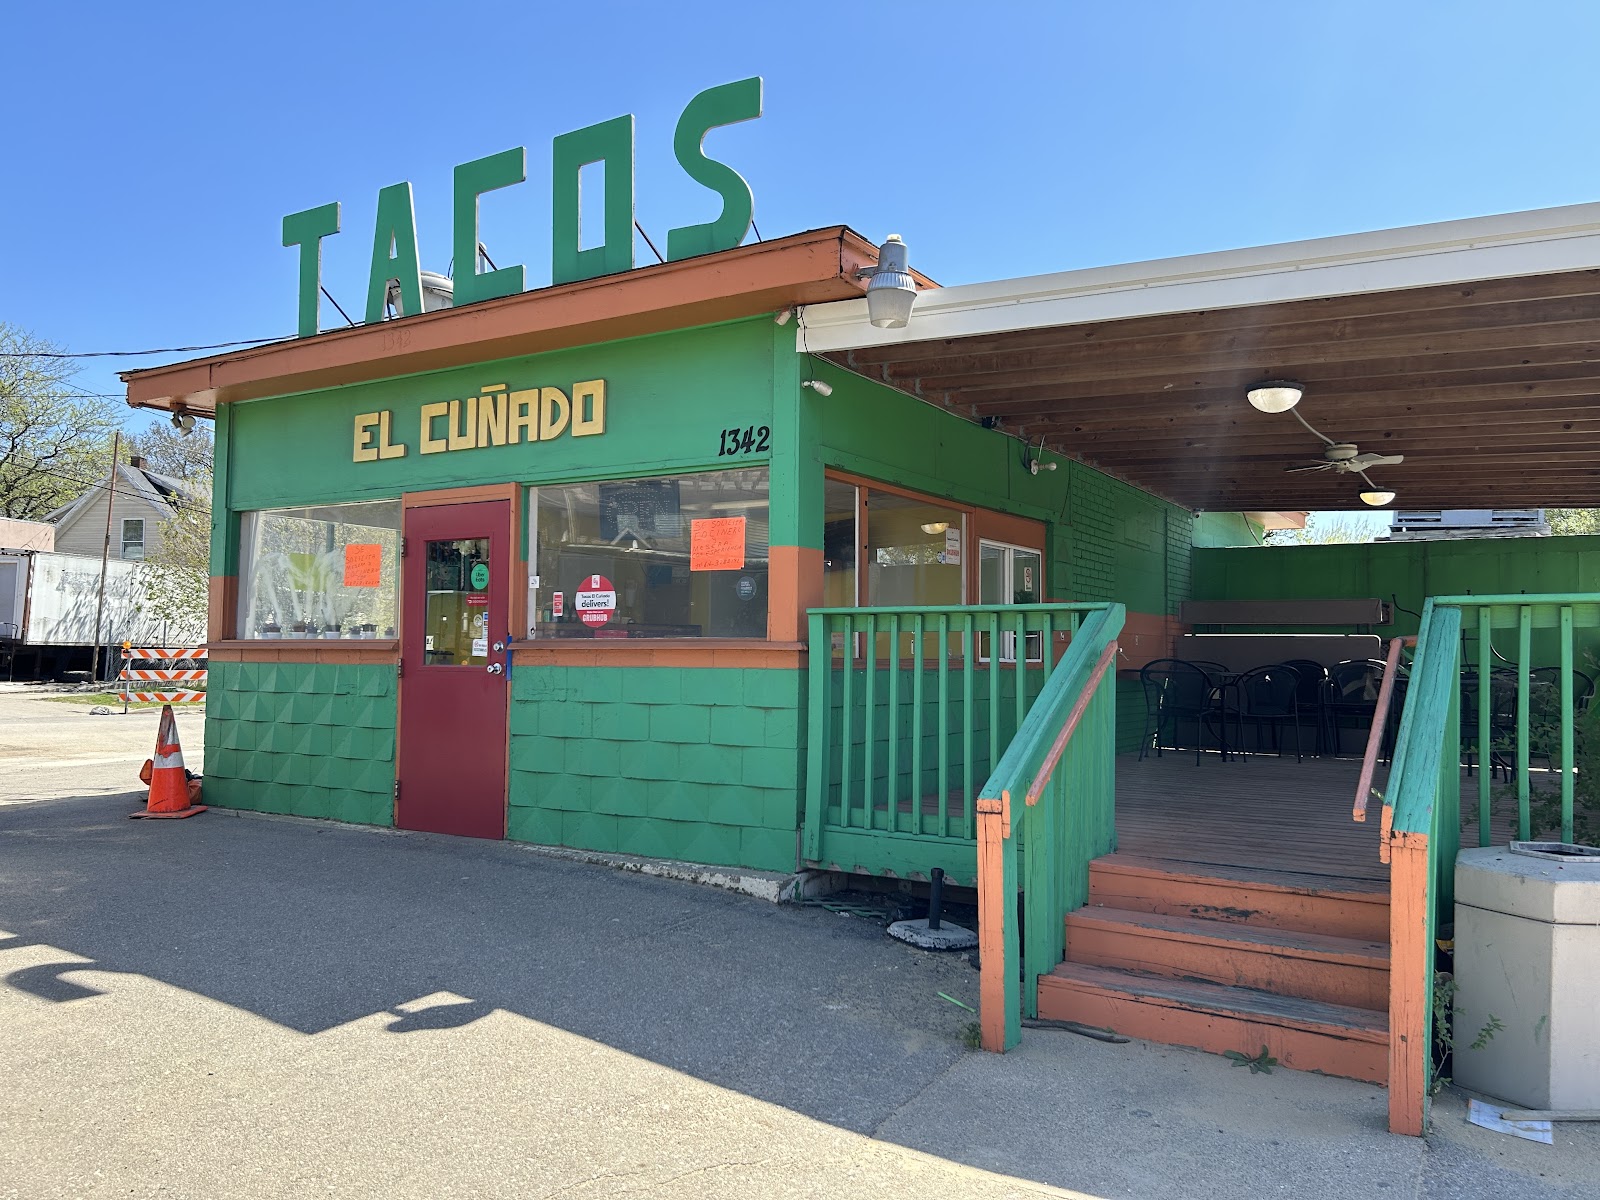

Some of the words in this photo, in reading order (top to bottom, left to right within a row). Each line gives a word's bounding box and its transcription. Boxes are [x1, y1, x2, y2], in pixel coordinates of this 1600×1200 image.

[282, 76, 763, 336] TACOS
[353, 410, 407, 462] EL
[420, 379, 606, 455] CUÑADO
[719, 426, 770, 456] 1342
[581, 599, 610, 607] delivers!
